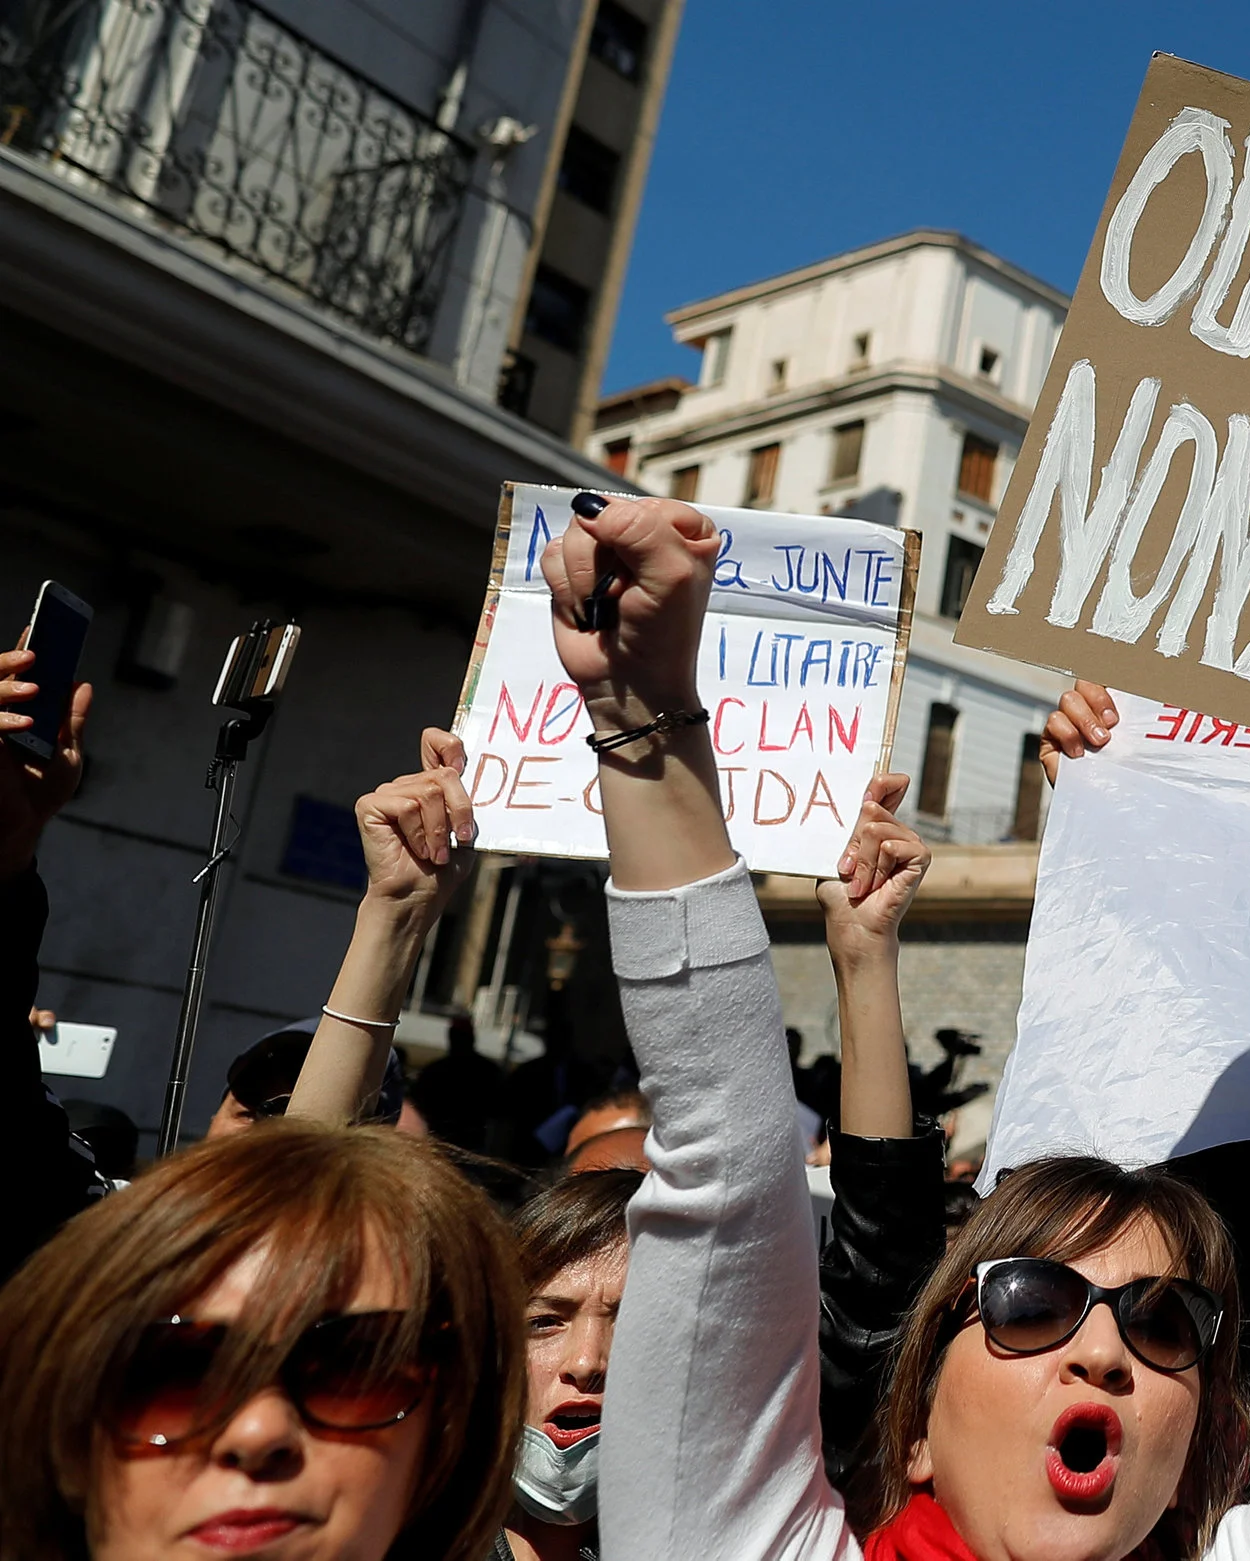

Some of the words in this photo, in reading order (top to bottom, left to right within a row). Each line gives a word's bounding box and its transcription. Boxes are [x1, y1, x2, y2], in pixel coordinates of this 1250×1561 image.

[771, 545, 895, 606] JUNTE
[718, 626, 885, 690] ILITAIRE
[712, 697, 862, 754] CLAN
